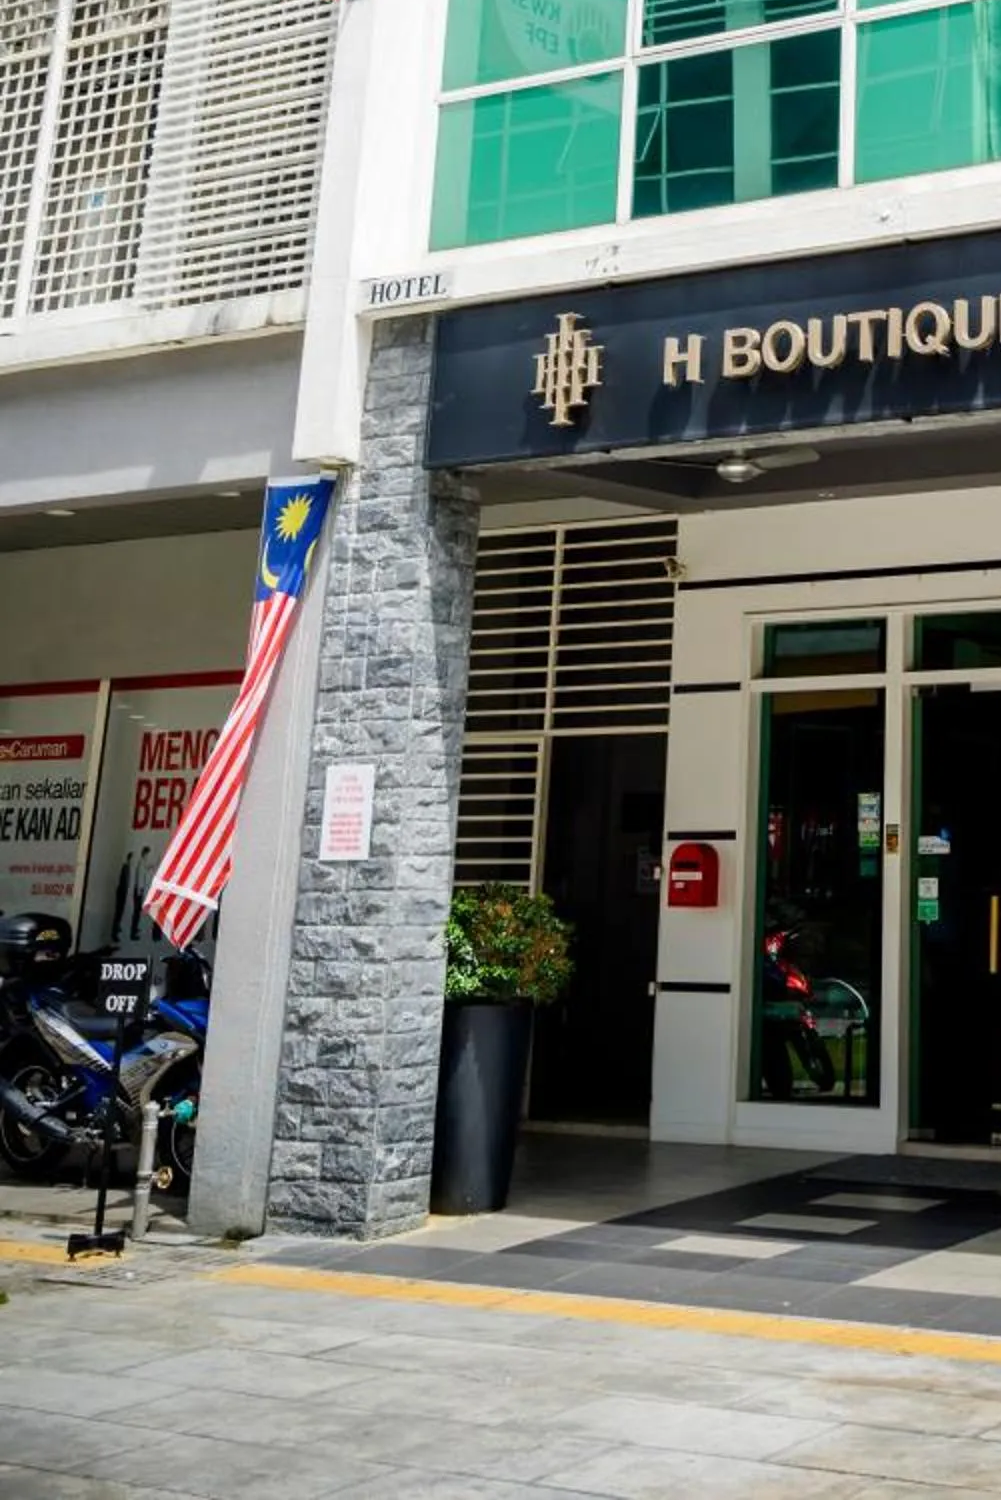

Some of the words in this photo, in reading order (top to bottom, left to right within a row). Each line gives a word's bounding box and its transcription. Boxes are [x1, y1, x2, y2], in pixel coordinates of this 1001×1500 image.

[369, 273, 447, 304] HOTEL
[663, 333, 706, 386] H
[132, 777, 200, 830] BER
[54, 806, 81, 840] AD
[101, 963, 148, 981] DROP
[105, 995, 138, 1012] OFF
